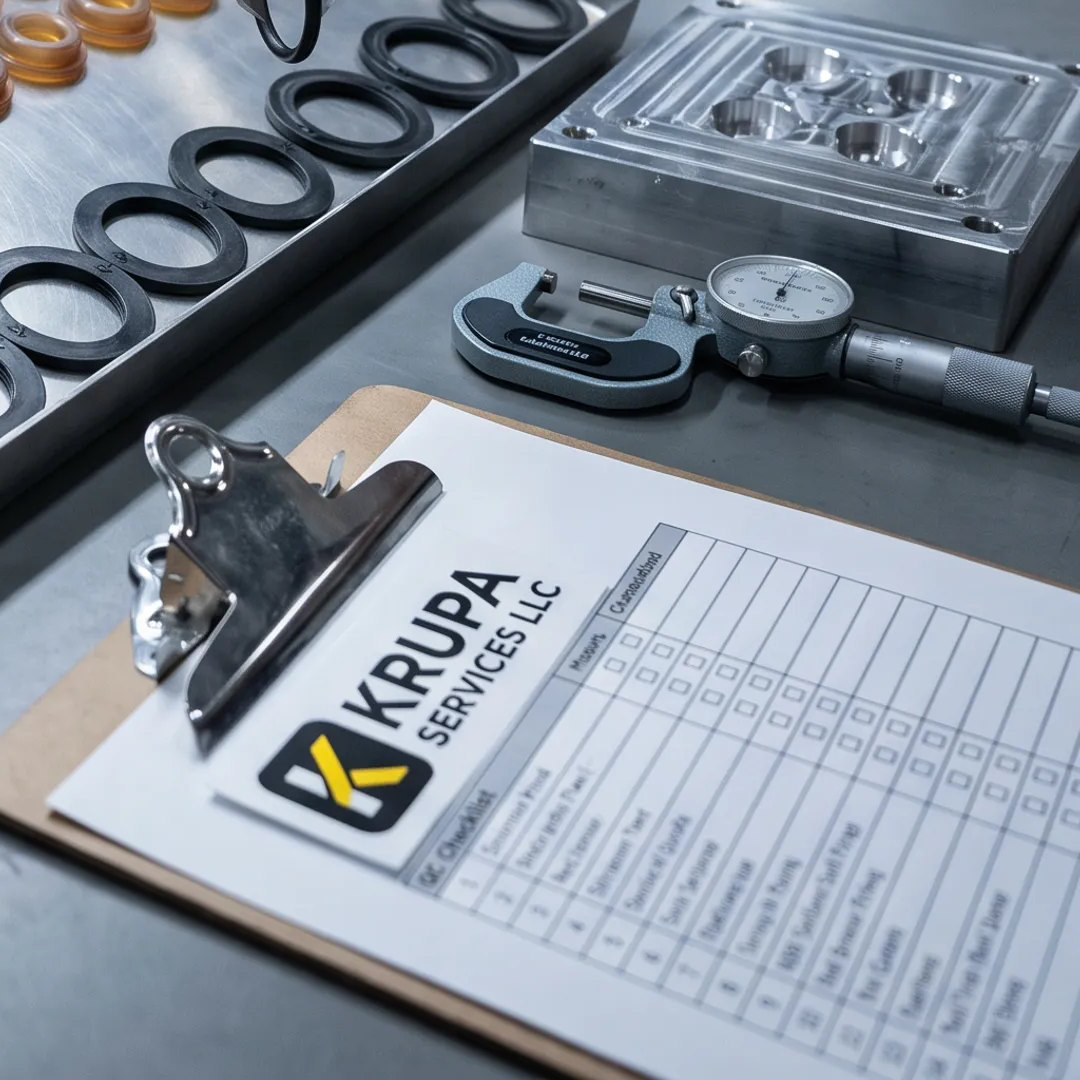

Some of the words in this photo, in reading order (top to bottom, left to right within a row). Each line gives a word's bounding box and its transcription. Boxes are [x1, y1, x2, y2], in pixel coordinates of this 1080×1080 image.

[341, 569, 520, 730] KRUPA
[418, 626, 527, 748] SERVICES
[509, 579, 561, 625] LLC
